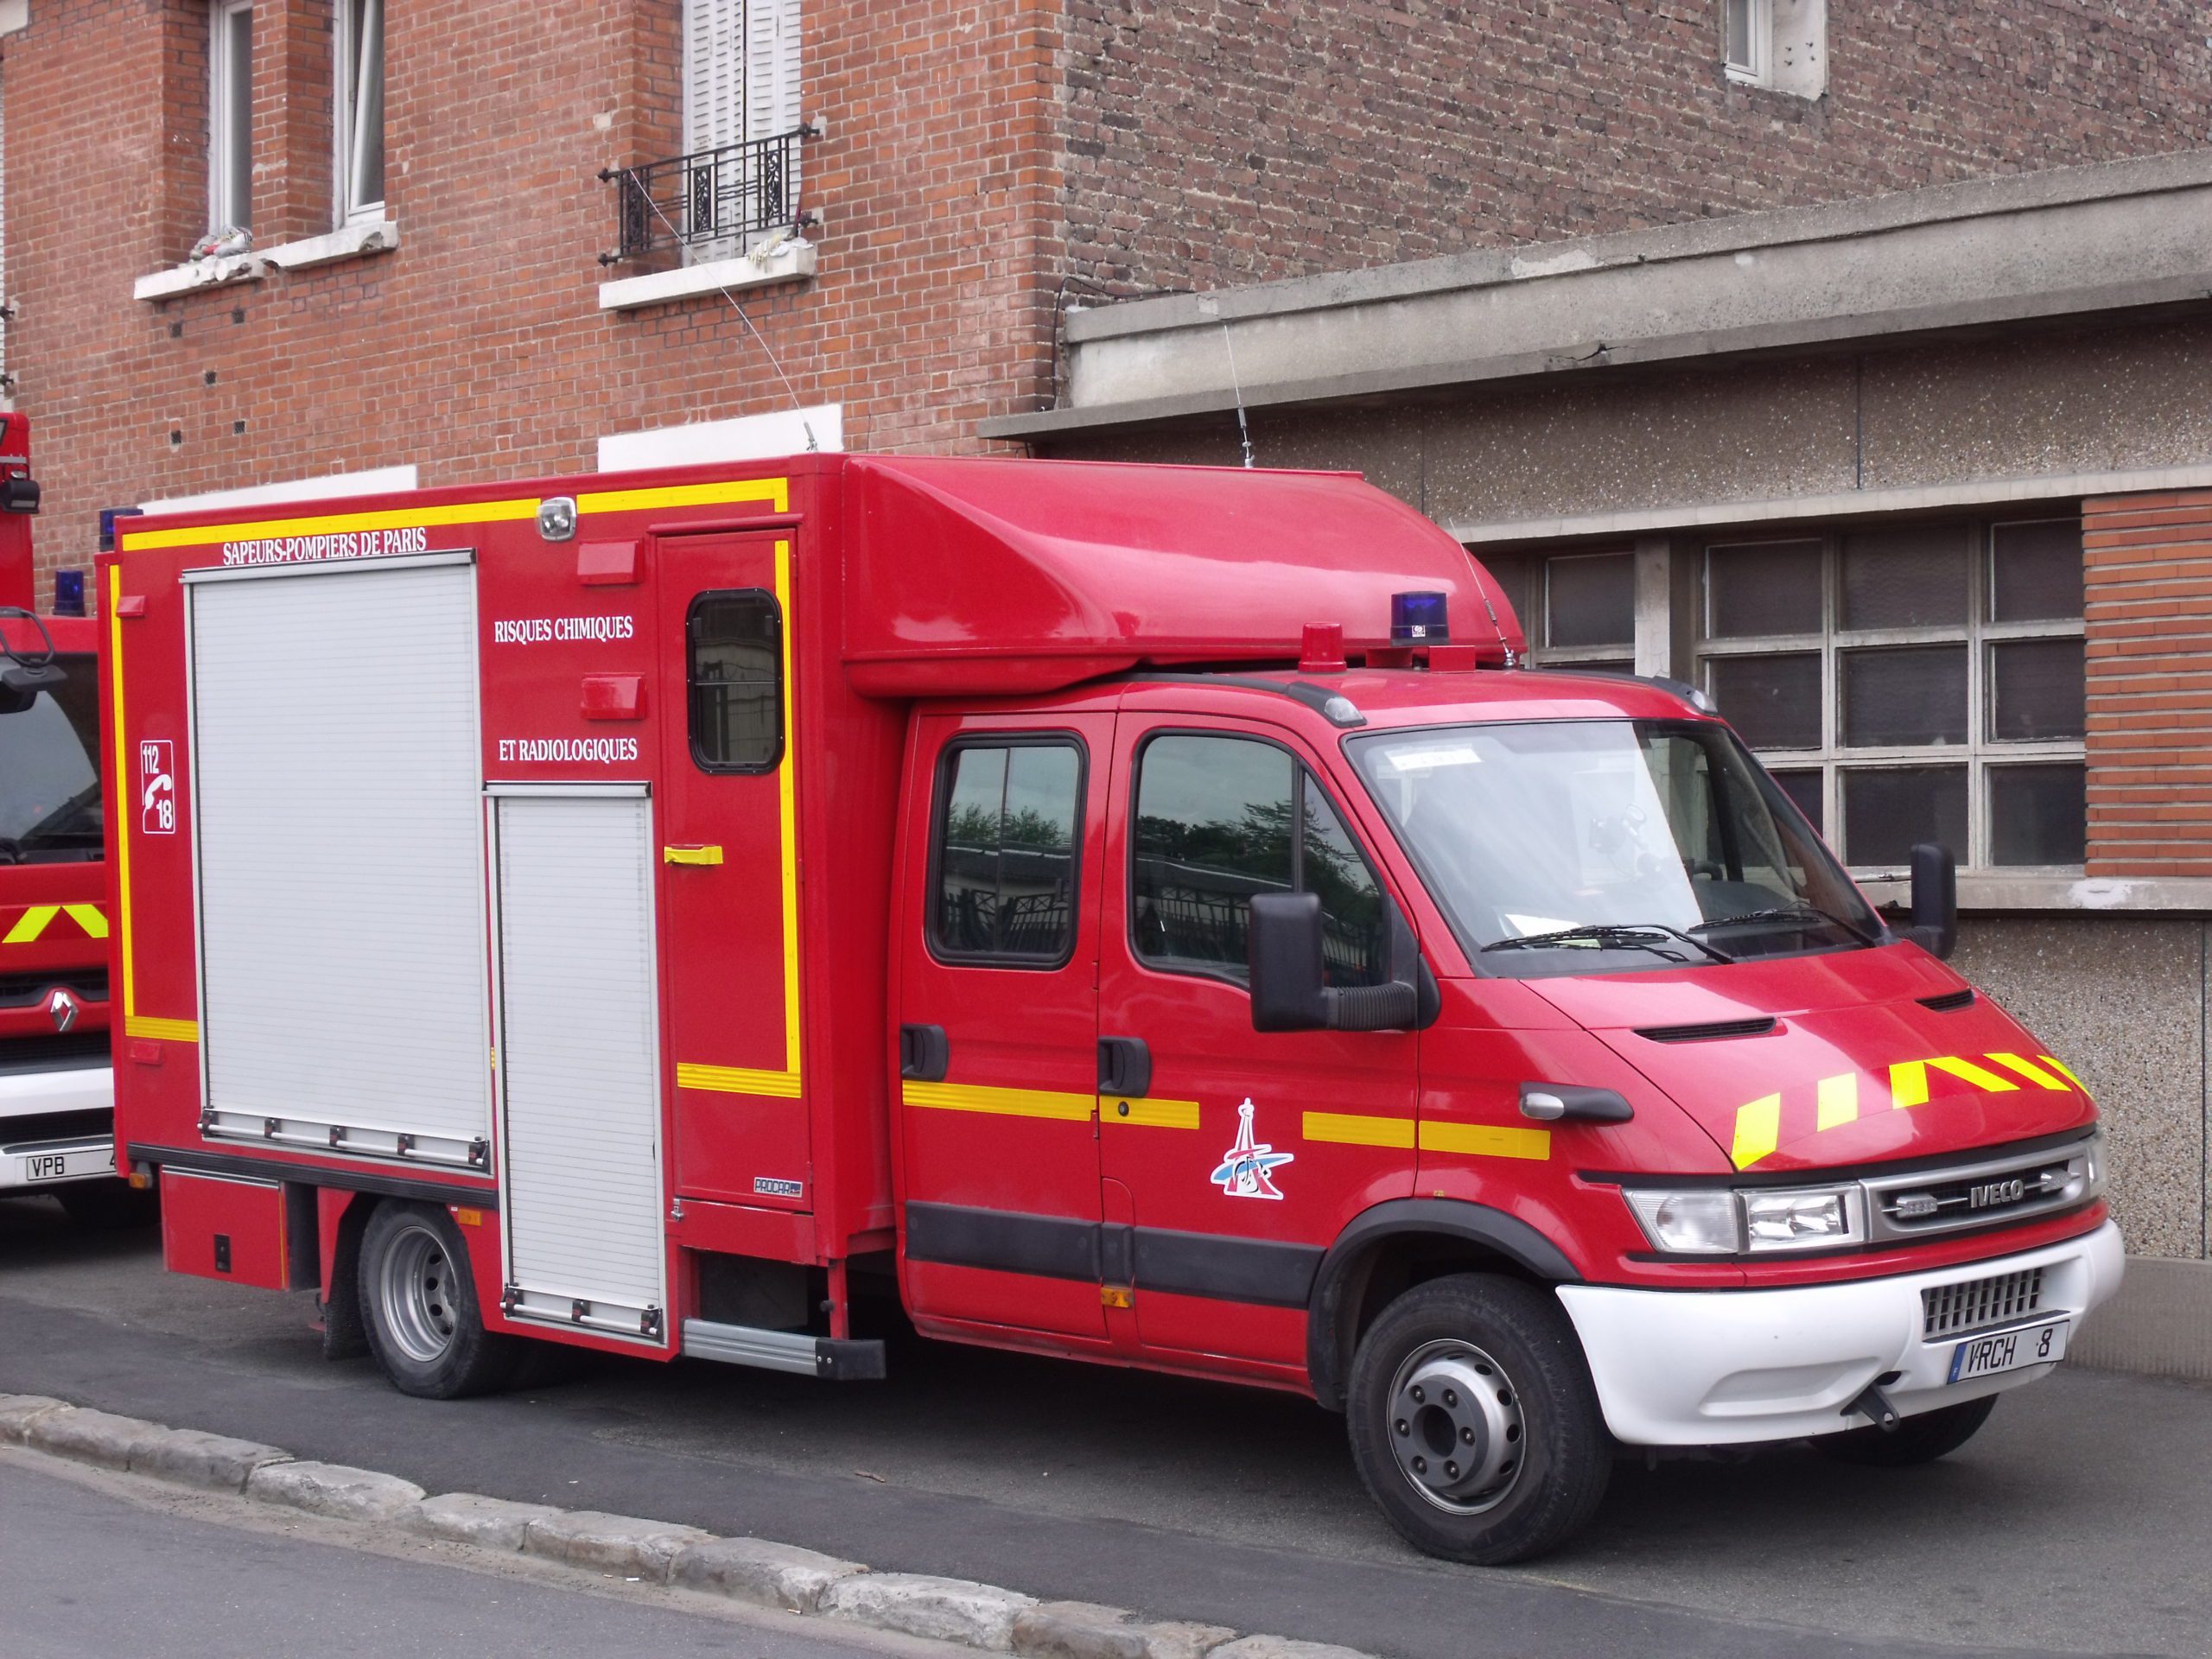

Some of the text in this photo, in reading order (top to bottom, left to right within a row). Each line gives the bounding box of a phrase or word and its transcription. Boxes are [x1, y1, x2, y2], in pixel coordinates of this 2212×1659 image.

[223, 526, 427, 565] SAPEURS-POMPIERS DE PARIS
[494, 615, 633, 645] RISQUES CHIMIQUES
[143, 745, 159, 773] 112
[499, 738, 638, 764] ET RADIOLOGIQUES
[156, 799, 173, 830] 18
[32, 1156, 65, 1177] VPB
[755, 1179, 790, 1194] PROCAR
[1970, 1179, 2024, 1208] IVECO
[1967, 1328, 2054, 1373] VRCH 8
